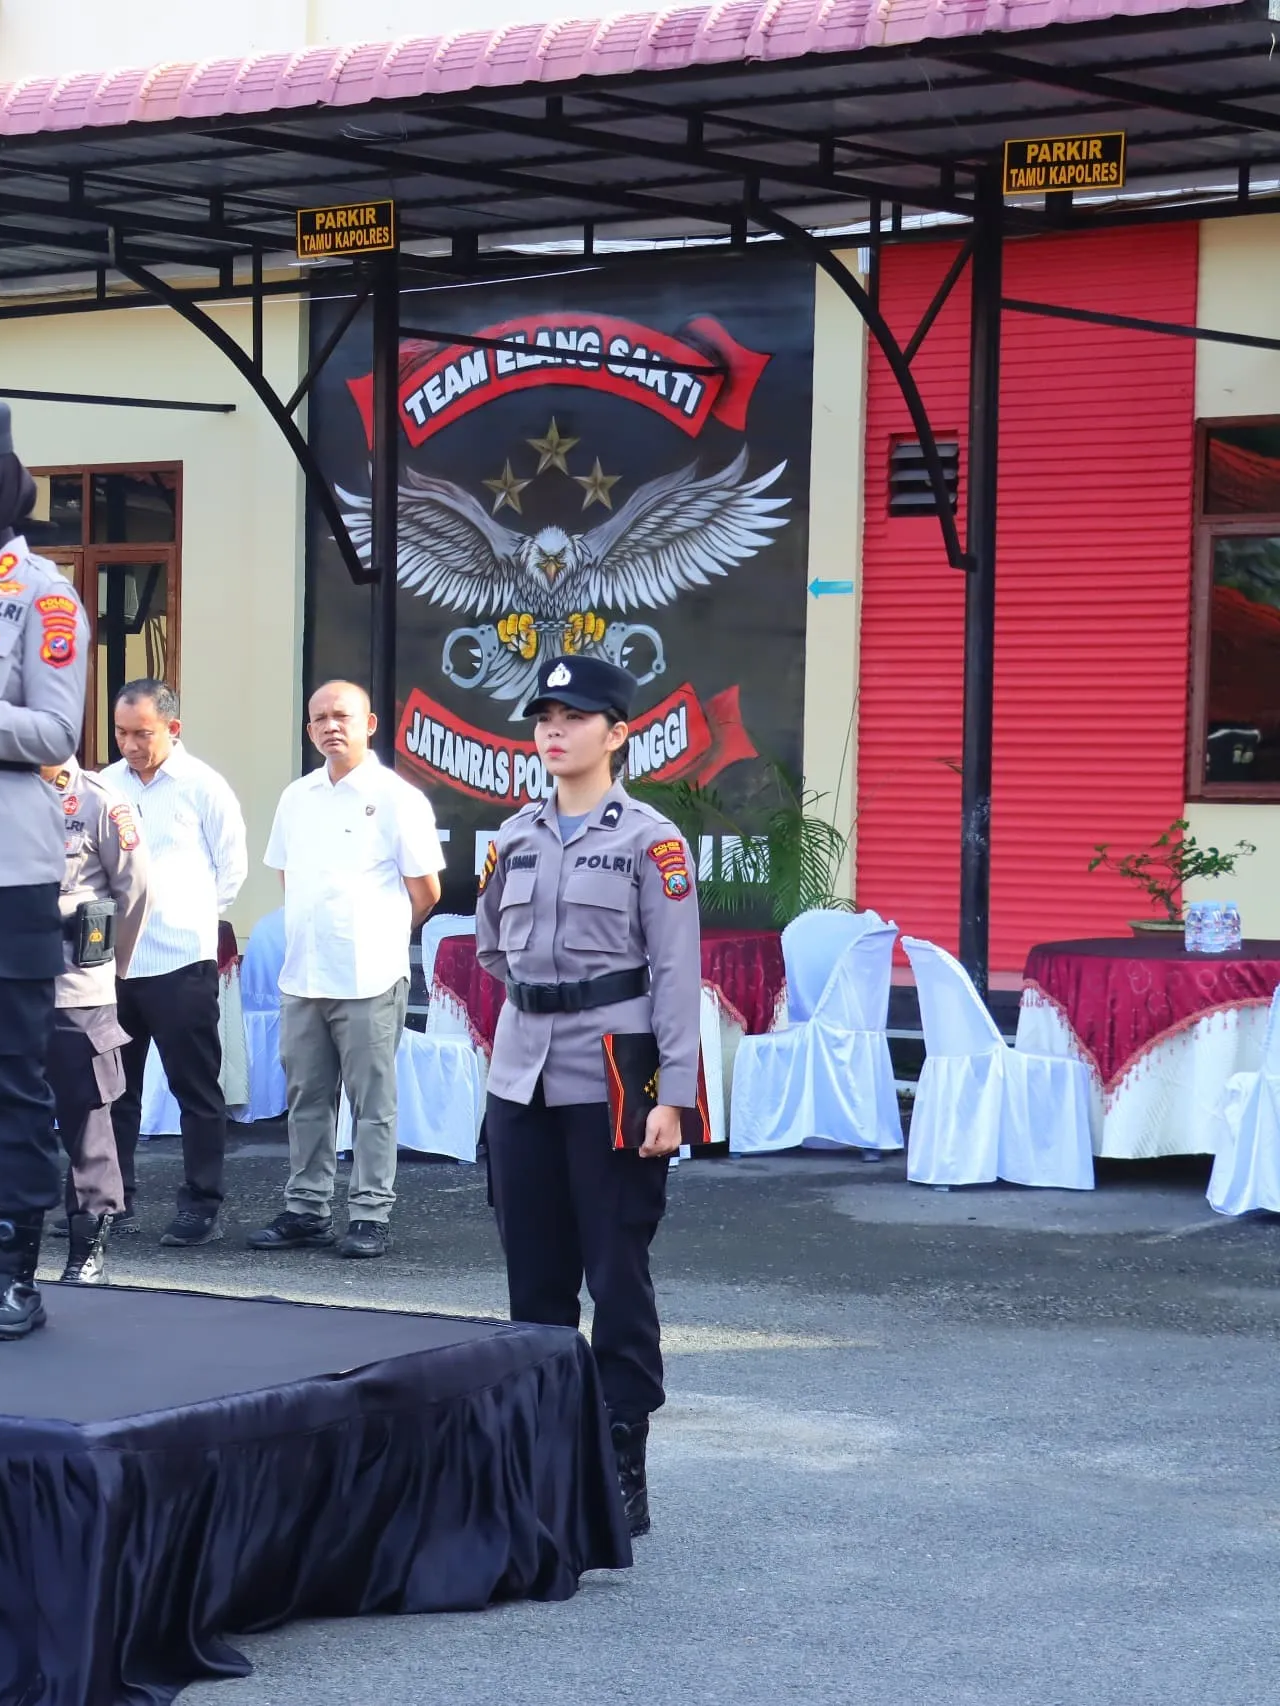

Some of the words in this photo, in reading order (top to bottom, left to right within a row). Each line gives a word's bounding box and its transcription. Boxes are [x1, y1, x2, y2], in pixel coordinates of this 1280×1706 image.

[1026, 140, 1103, 164] PARKIR
[1010, 166, 1046, 188] TAMU
[1049, 162, 1118, 185] KAPOLRES
[315, 207, 376, 230] PARKIR
[303, 233, 332, 252] TAMU
[335, 226, 390, 249] KAPOLRES
[403, 349, 488, 425] TEAM
[495, 330, 600, 374] ELANG
[607, 338, 702, 415] SAKTI
[405, 710, 510, 796] JATANRAS
[512, 753, 558, 800] POL
[627, 705, 688, 781] INGGI
[64, 818, 86, 833] LRI
[574, 855, 632, 873] POLRI
